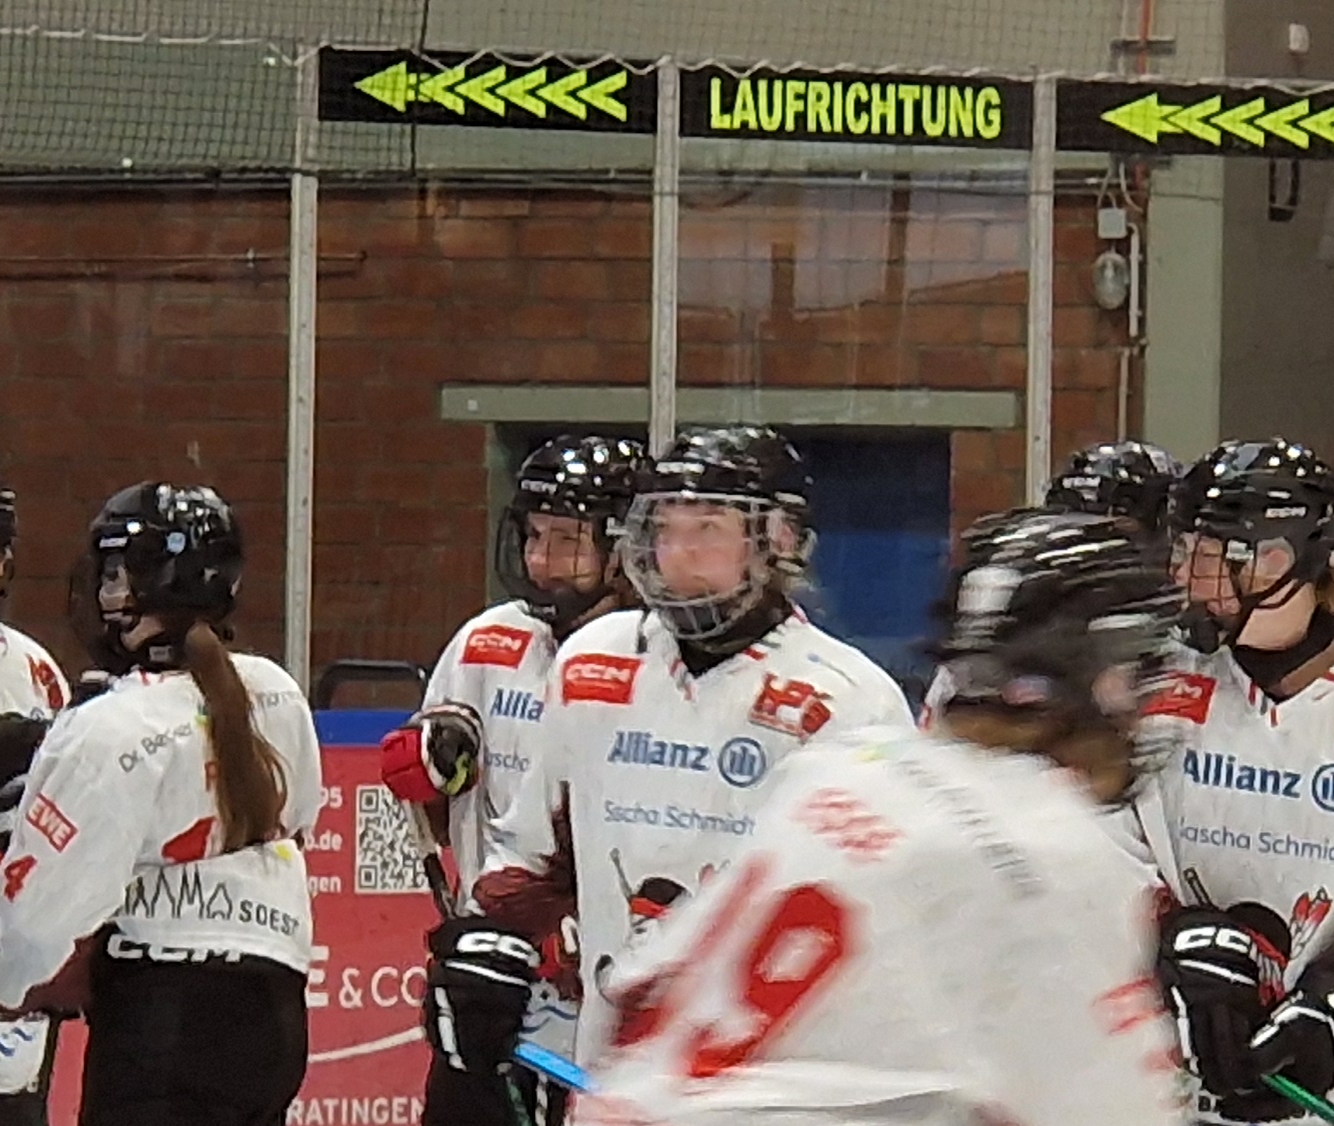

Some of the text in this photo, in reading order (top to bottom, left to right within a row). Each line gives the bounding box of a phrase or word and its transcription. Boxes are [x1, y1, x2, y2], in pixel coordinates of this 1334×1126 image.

[710, 77, 1002, 139] LAUFRICHTUNG
[468, 633, 523, 651] CCM
[565, 663, 632, 684] CCM
[607, 731, 710, 771] Allianz
[1182, 749, 1302, 798] Allianz
[238, 899, 300, 936] SOEST
[339, 967, 364, 1009] &
[285, 1096, 425, 1126] RATINGEN
